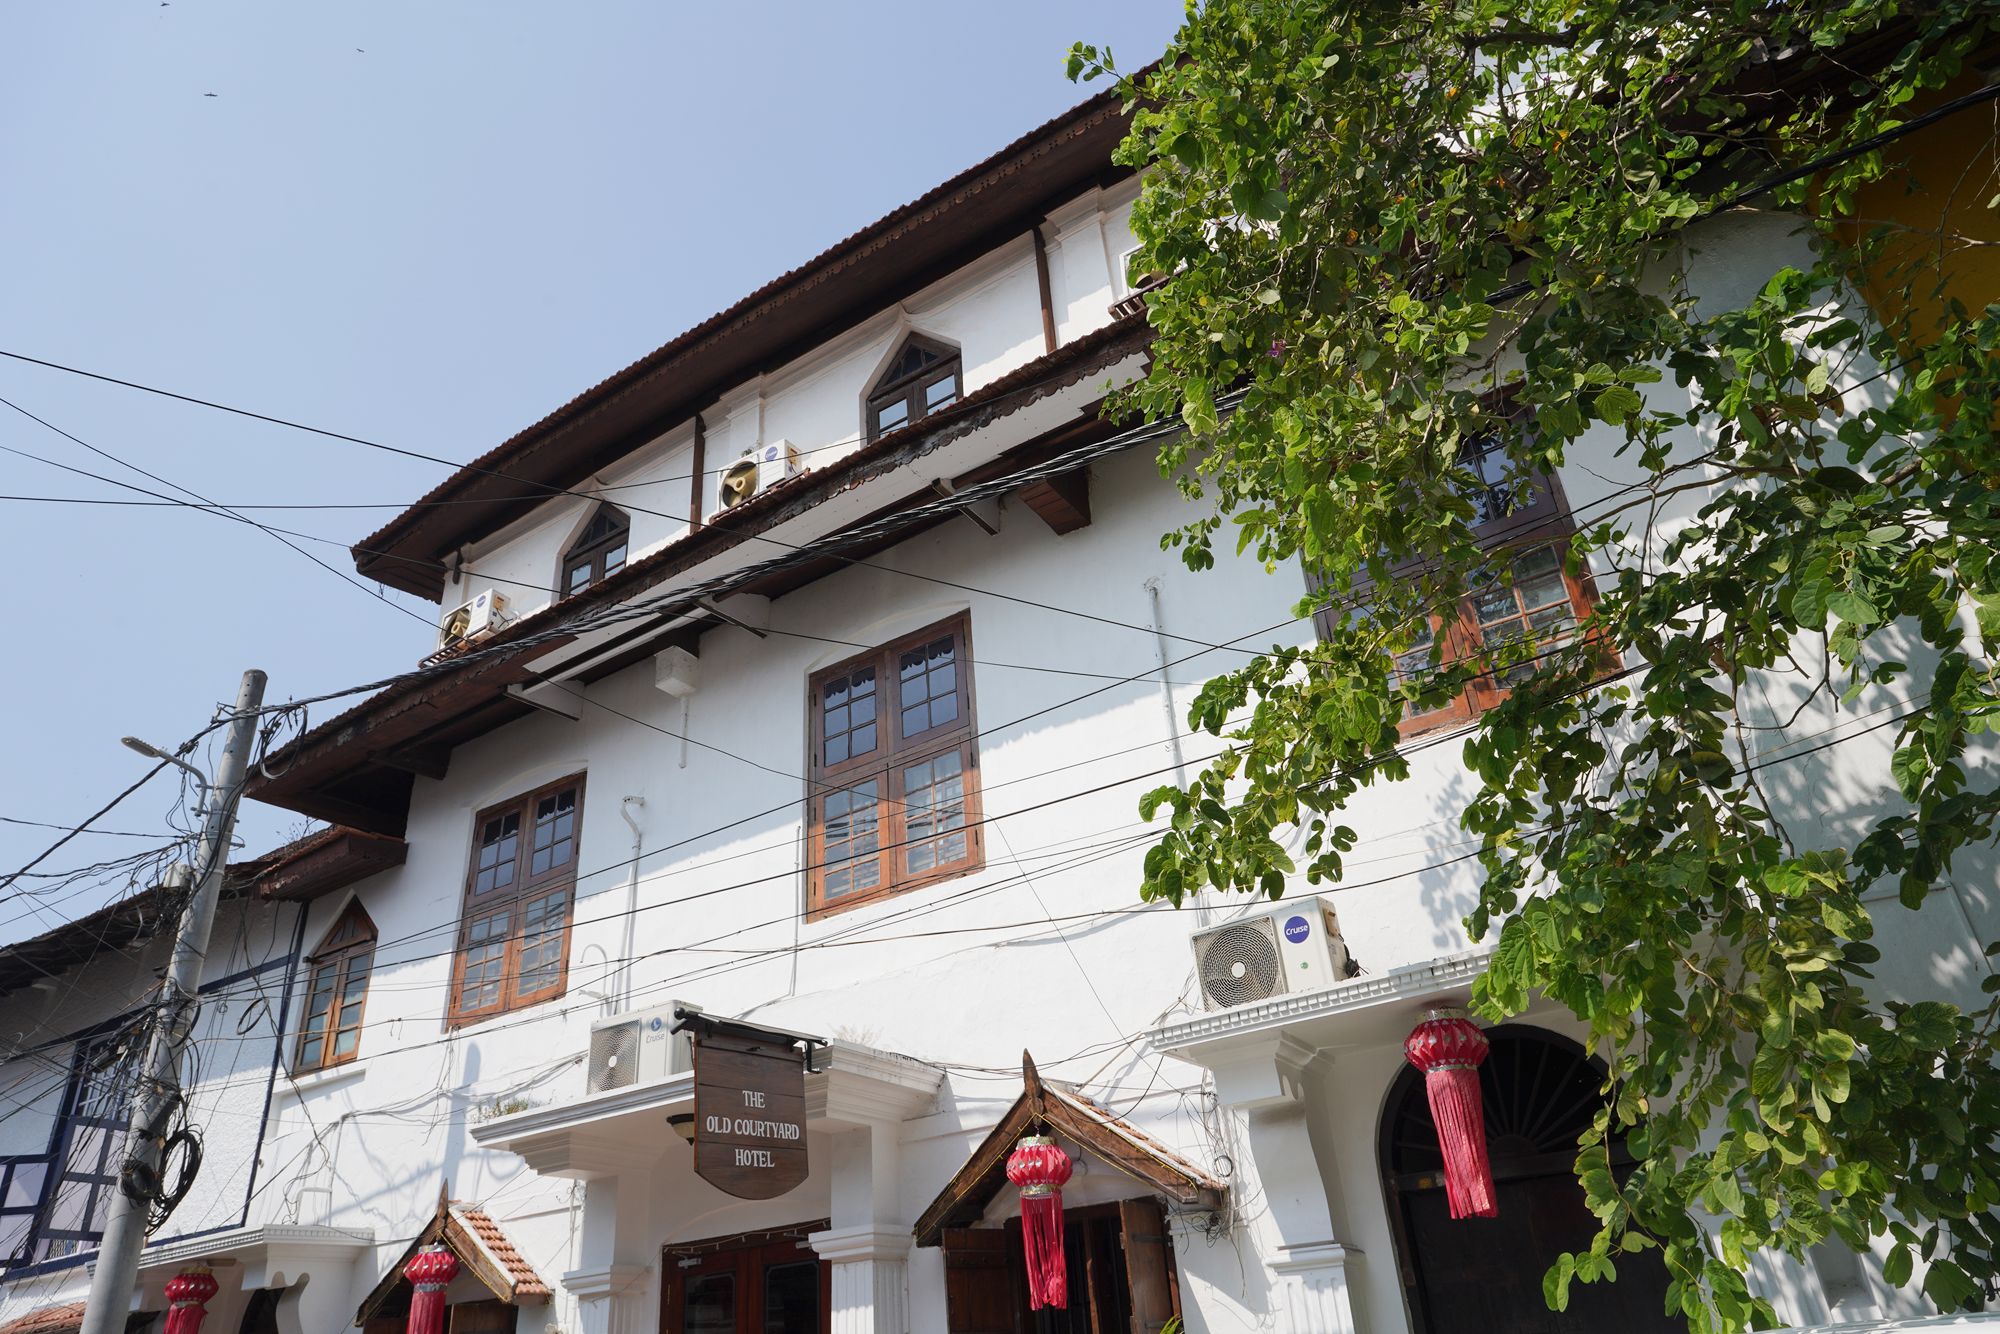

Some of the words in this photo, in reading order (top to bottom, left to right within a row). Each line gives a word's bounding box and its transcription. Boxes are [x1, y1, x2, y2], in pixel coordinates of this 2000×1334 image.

[1286, 925, 1308, 935] Cruise
[742, 1090, 766, 1109] THE
[706, 1116, 732, 1134] OLD
[734, 1119, 800, 1140] COURTYARD
[735, 1149, 775, 1168] HOTEL
